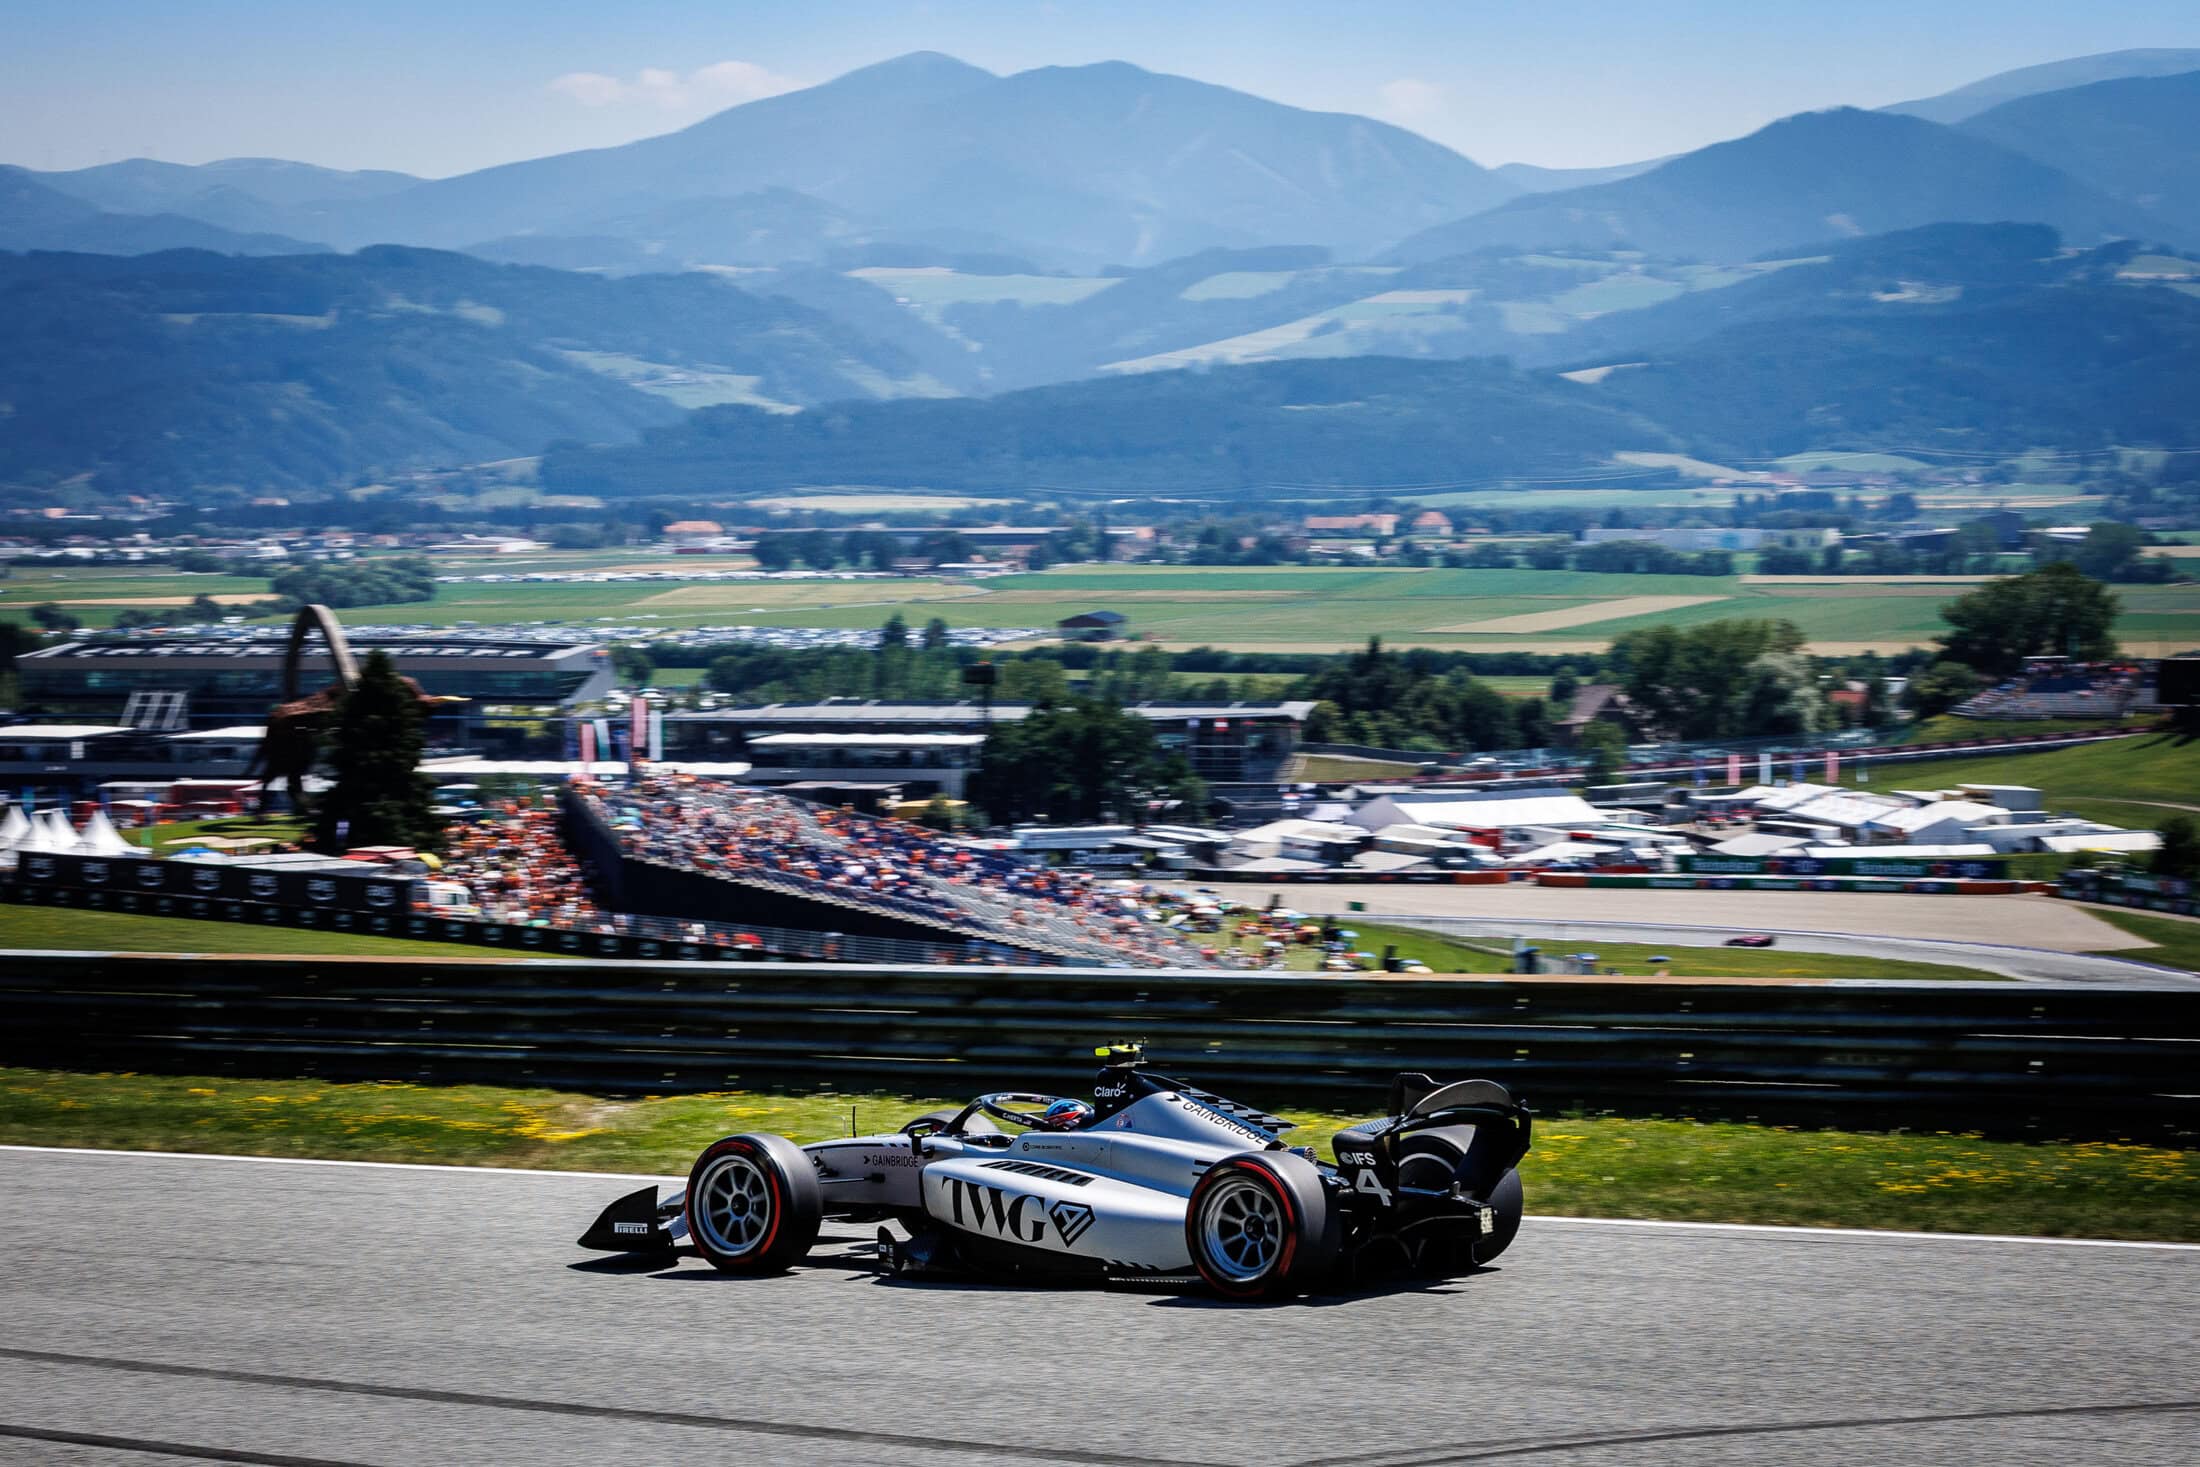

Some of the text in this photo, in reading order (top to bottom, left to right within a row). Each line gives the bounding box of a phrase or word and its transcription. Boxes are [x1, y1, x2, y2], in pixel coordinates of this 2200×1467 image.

[1094, 1086, 1121, 1097] Claro
[1183, 1101, 1271, 1145] GAINBRIDGE
[872, 1154, 919, 1168] GAINBRIDGE
[1352, 1152, 1377, 1166] IFS
[1355, 1168, 1392, 1207] 4
[942, 1176, 1047, 1242] TWG
[614, 1222, 648, 1234] PIRELLI
